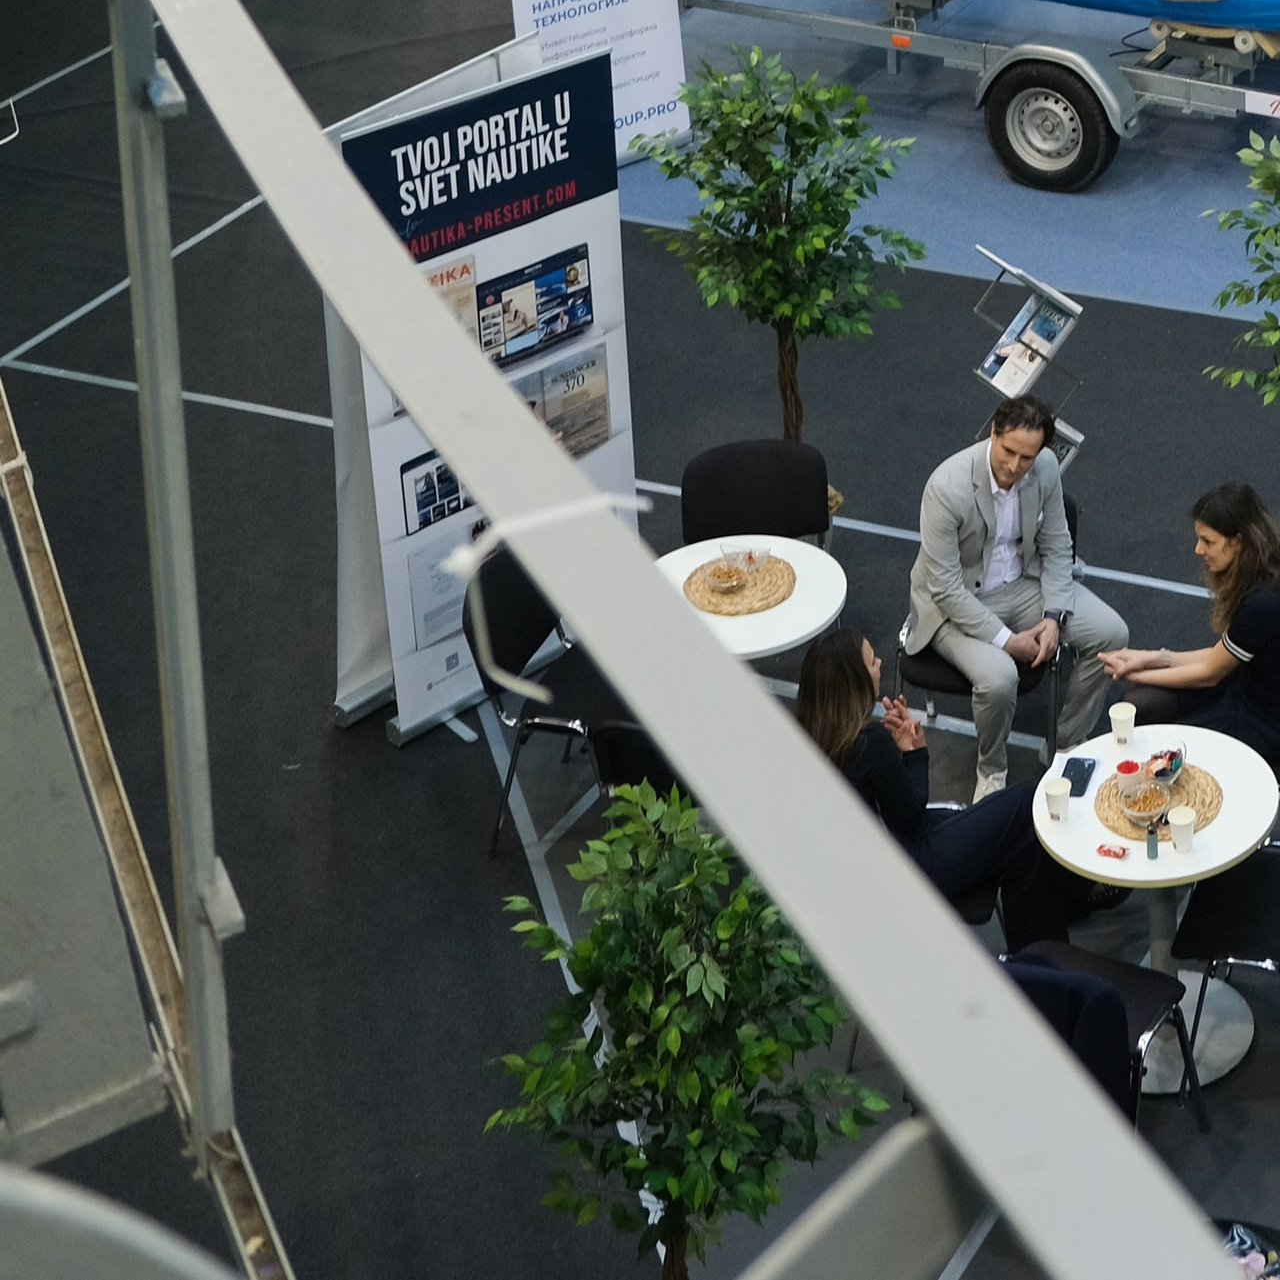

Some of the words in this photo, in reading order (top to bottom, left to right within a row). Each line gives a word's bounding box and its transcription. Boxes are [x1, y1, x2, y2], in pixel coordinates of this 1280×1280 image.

[613, 49, 647, 67] ројекти
[612, 70, 661, 91] нвестиције
[613, 100, 677, 131] OUP.PRO
[390, 131, 451, 183] TVOJ
[457, 99, 550, 162] PORTAL
[554, 90, 572, 127] U
[398, 162, 461, 218] SVET
[467, 125, 570, 194] NAUTIKE
[407, 180, 577, 259] AUTIKA-PRESENT.COM
[426, 262, 473, 289] TIKA
[551, 359, 597, 384] SUNDANCER
[562, 372, 586, 395] 370
